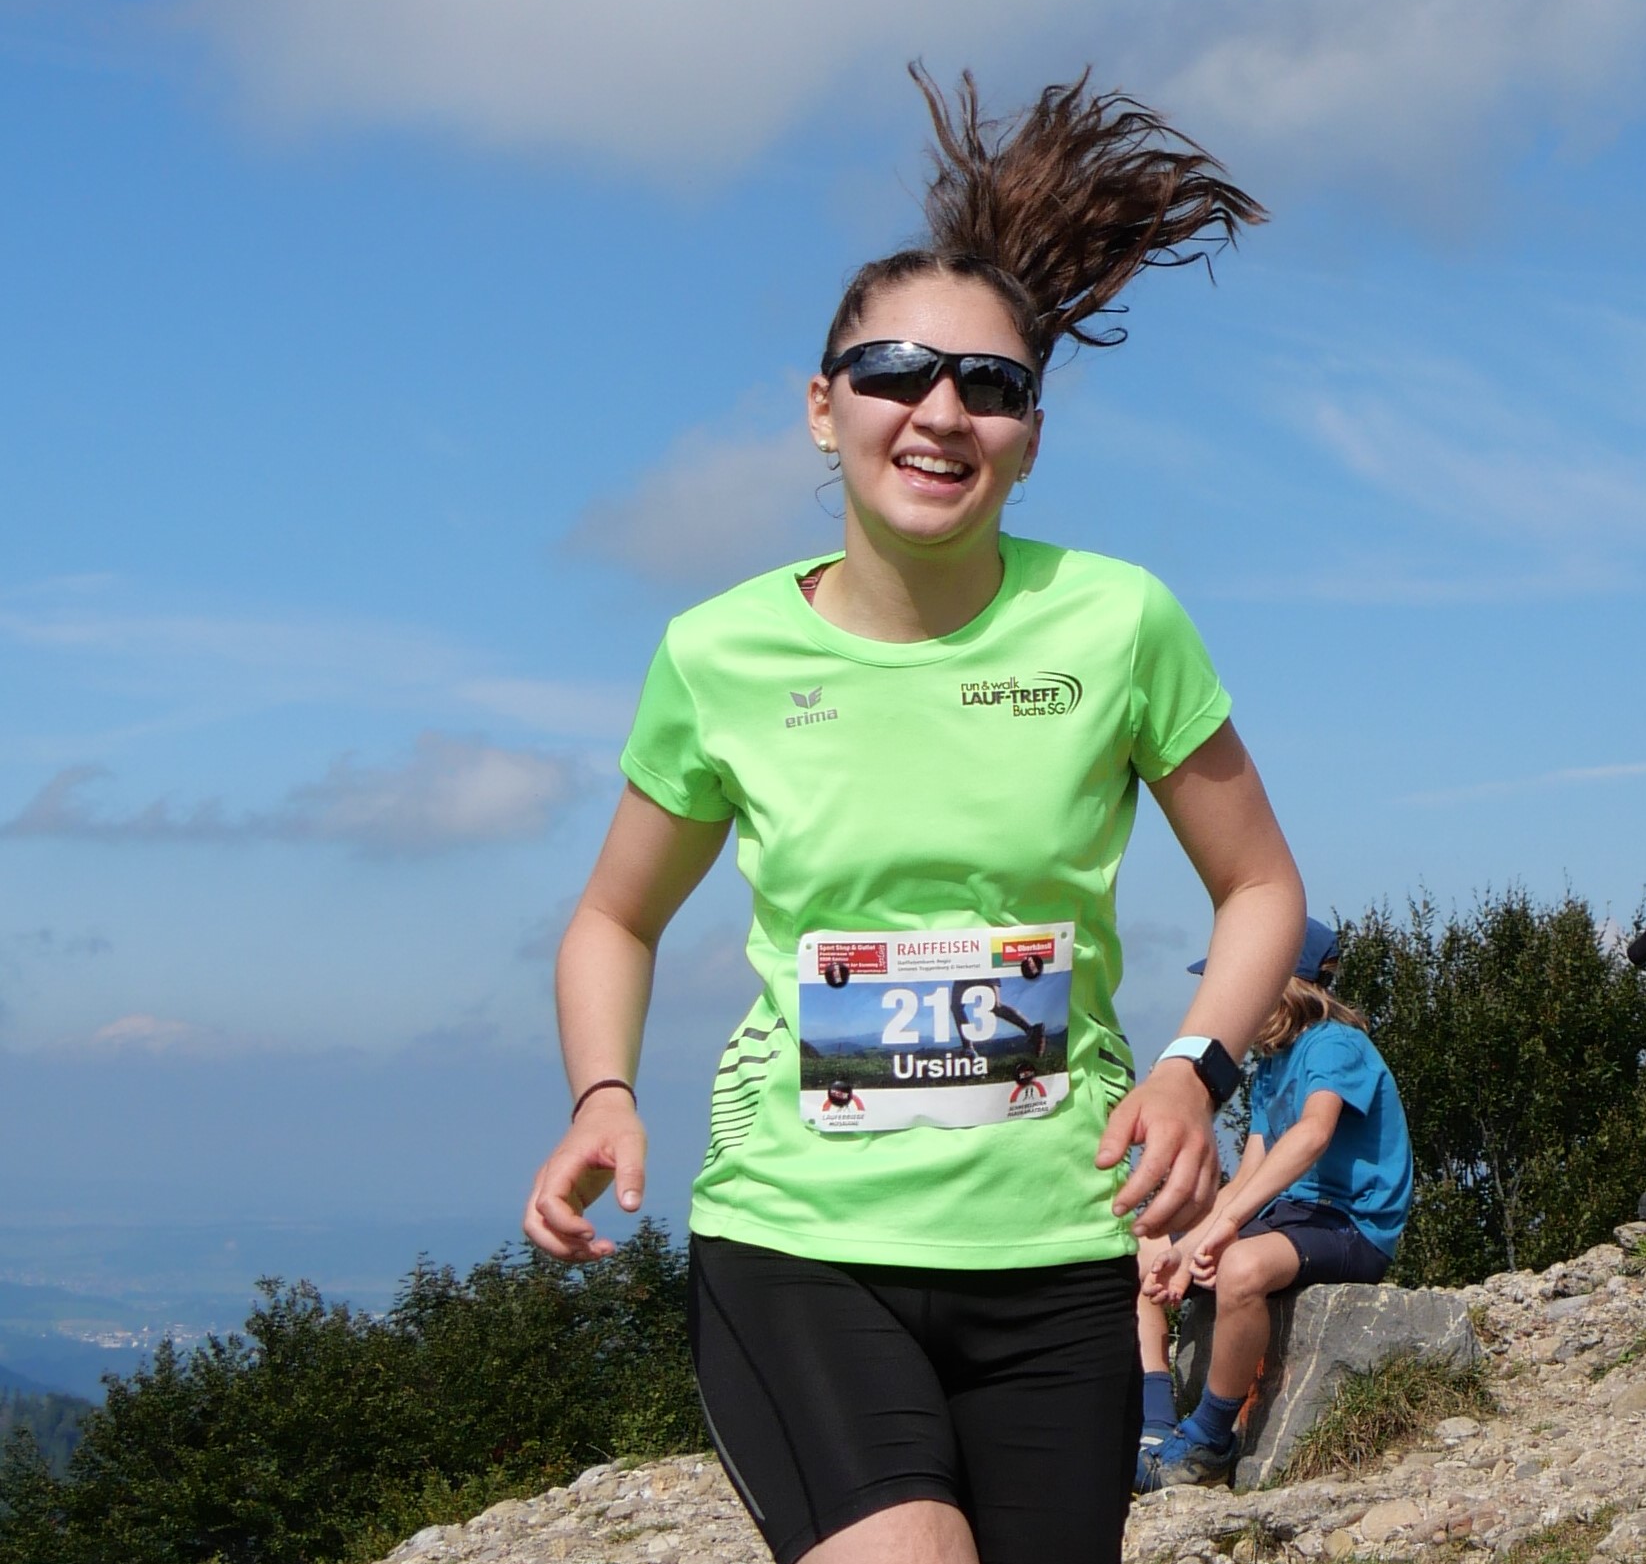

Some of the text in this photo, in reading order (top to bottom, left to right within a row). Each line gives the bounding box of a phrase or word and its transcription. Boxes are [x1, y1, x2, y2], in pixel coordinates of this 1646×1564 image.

[961, 676, 1019, 692] run & walk
[961, 687, 1060, 706] LAUF-TREFF
[785, 708, 838, 729] erima
[1013, 702, 1066, 717] Buchs SG
[897, 940, 980, 956] RAIFFEISEN
[881, 985, 997, 1045] 213
[893, 1052, 989, 1079] Ursina
